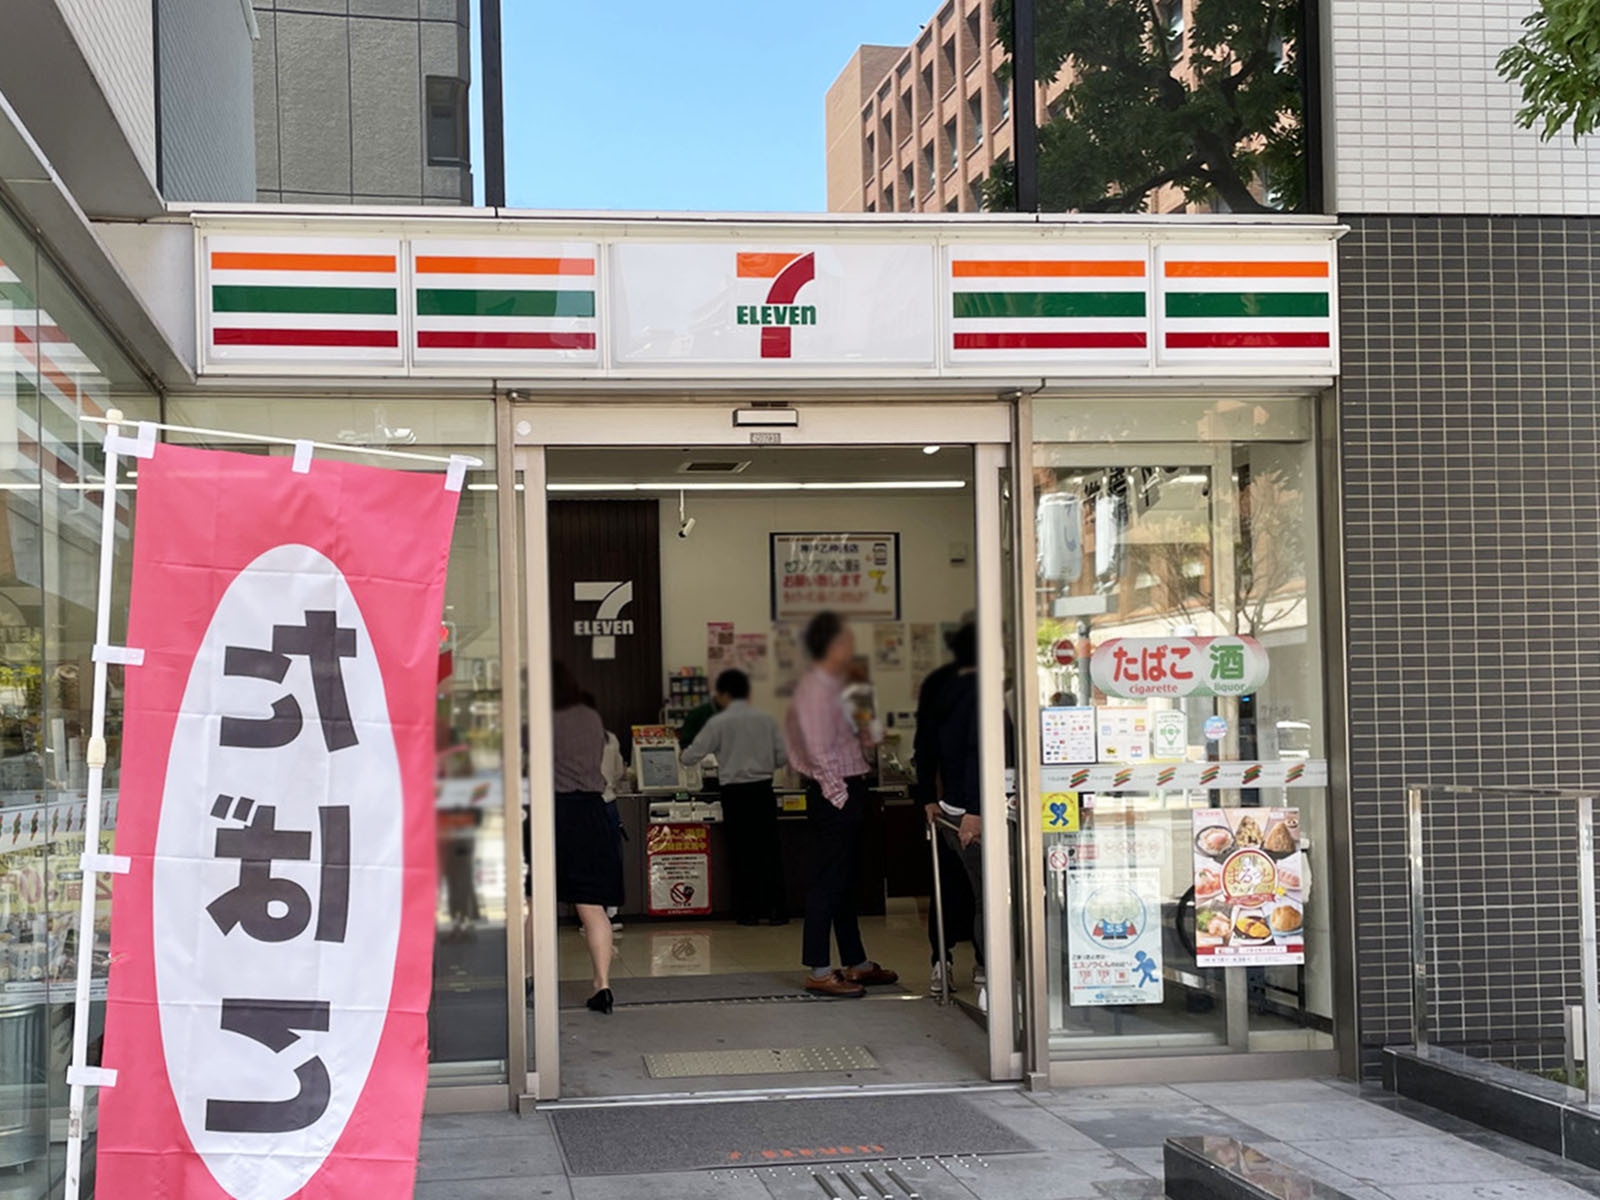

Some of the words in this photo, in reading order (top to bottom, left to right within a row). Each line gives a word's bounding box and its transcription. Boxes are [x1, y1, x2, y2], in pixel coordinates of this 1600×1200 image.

[1113, 645, 1194, 682] たばこ
[1210, 644, 1245, 680] 酒
[1129, 684, 1179, 694] cigarette
[1214, 682, 1246, 692] liquor
